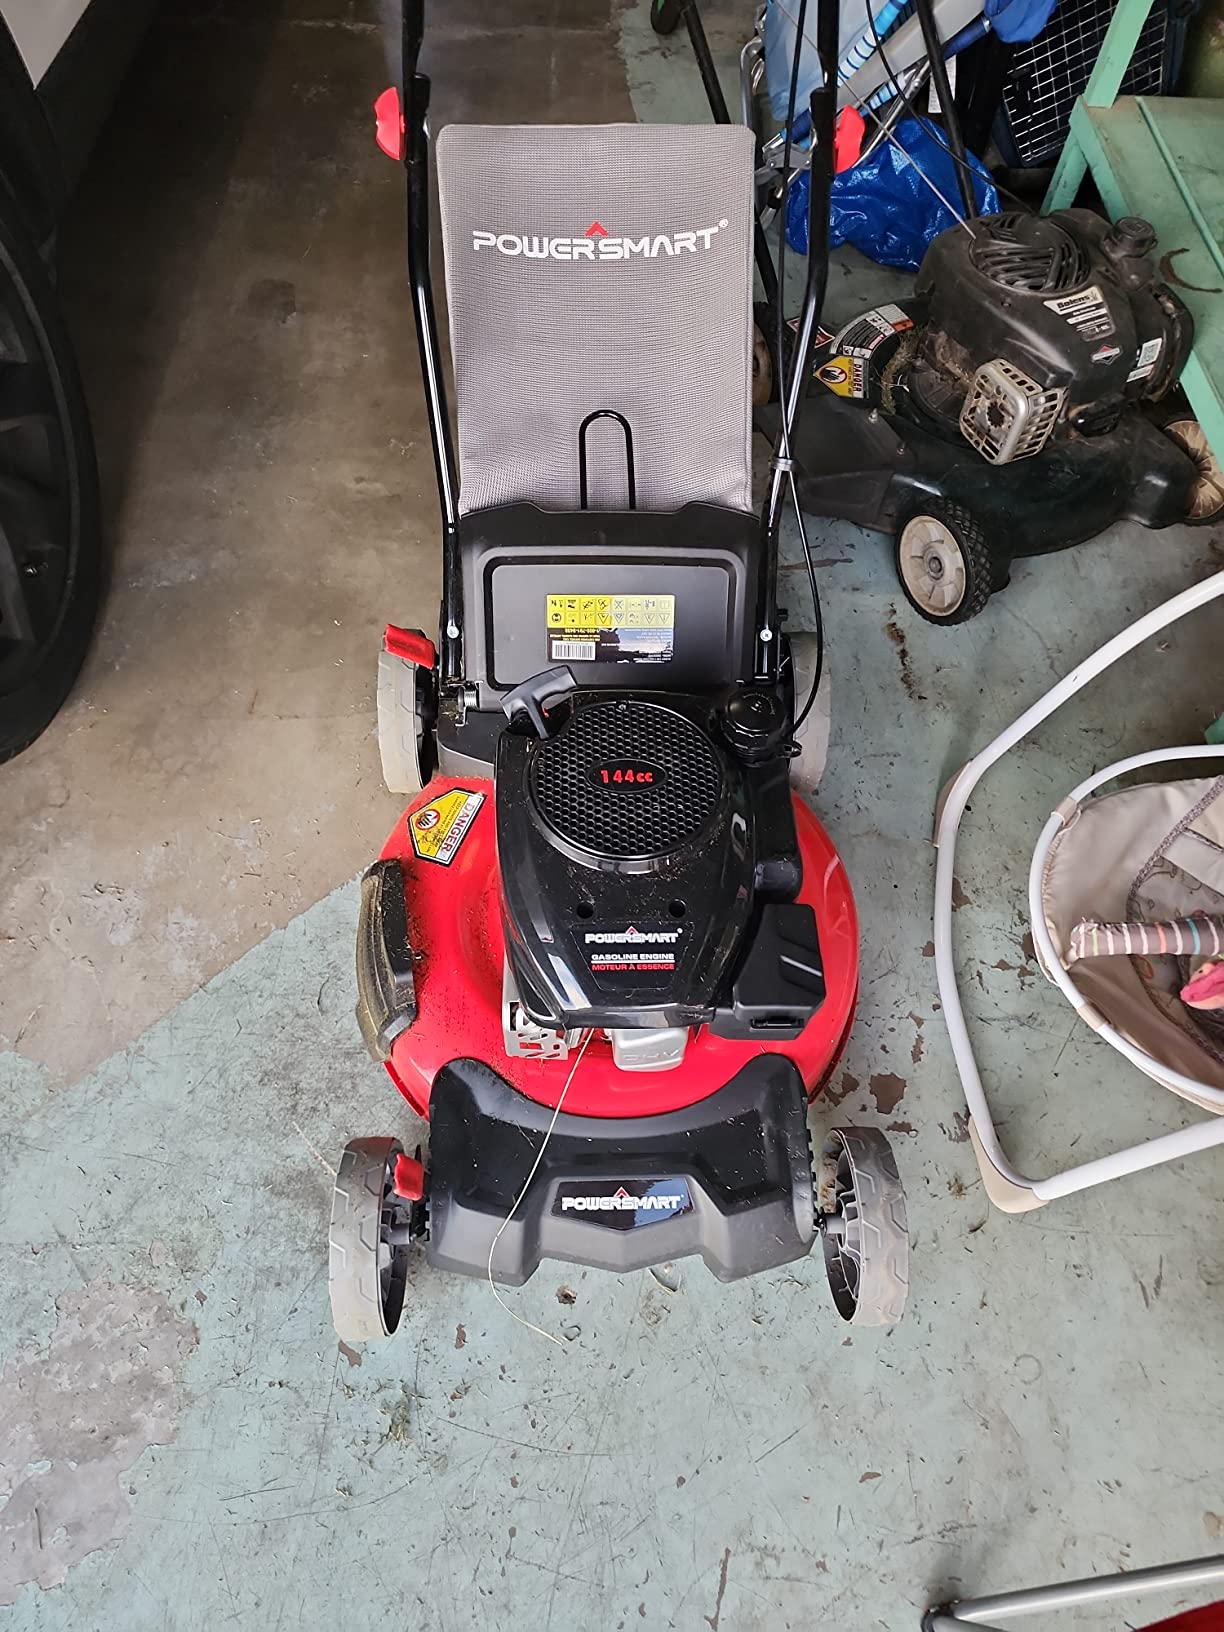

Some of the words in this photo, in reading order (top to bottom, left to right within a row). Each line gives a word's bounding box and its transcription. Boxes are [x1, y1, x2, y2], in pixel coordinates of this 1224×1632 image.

[472, 225, 719, 260] POWERSMART
[1057, 295, 1090, 308] Bolens
[600, 769, 653, 783] 144cc
[441, 803, 475, 852] DANGER
[584, 932, 679, 944] POWERSMART
[591, 953, 638, 961] GASOLINE
[591, 963, 627, 971] MOTEUR
[561, 1196, 681, 1211] POWERSMART
